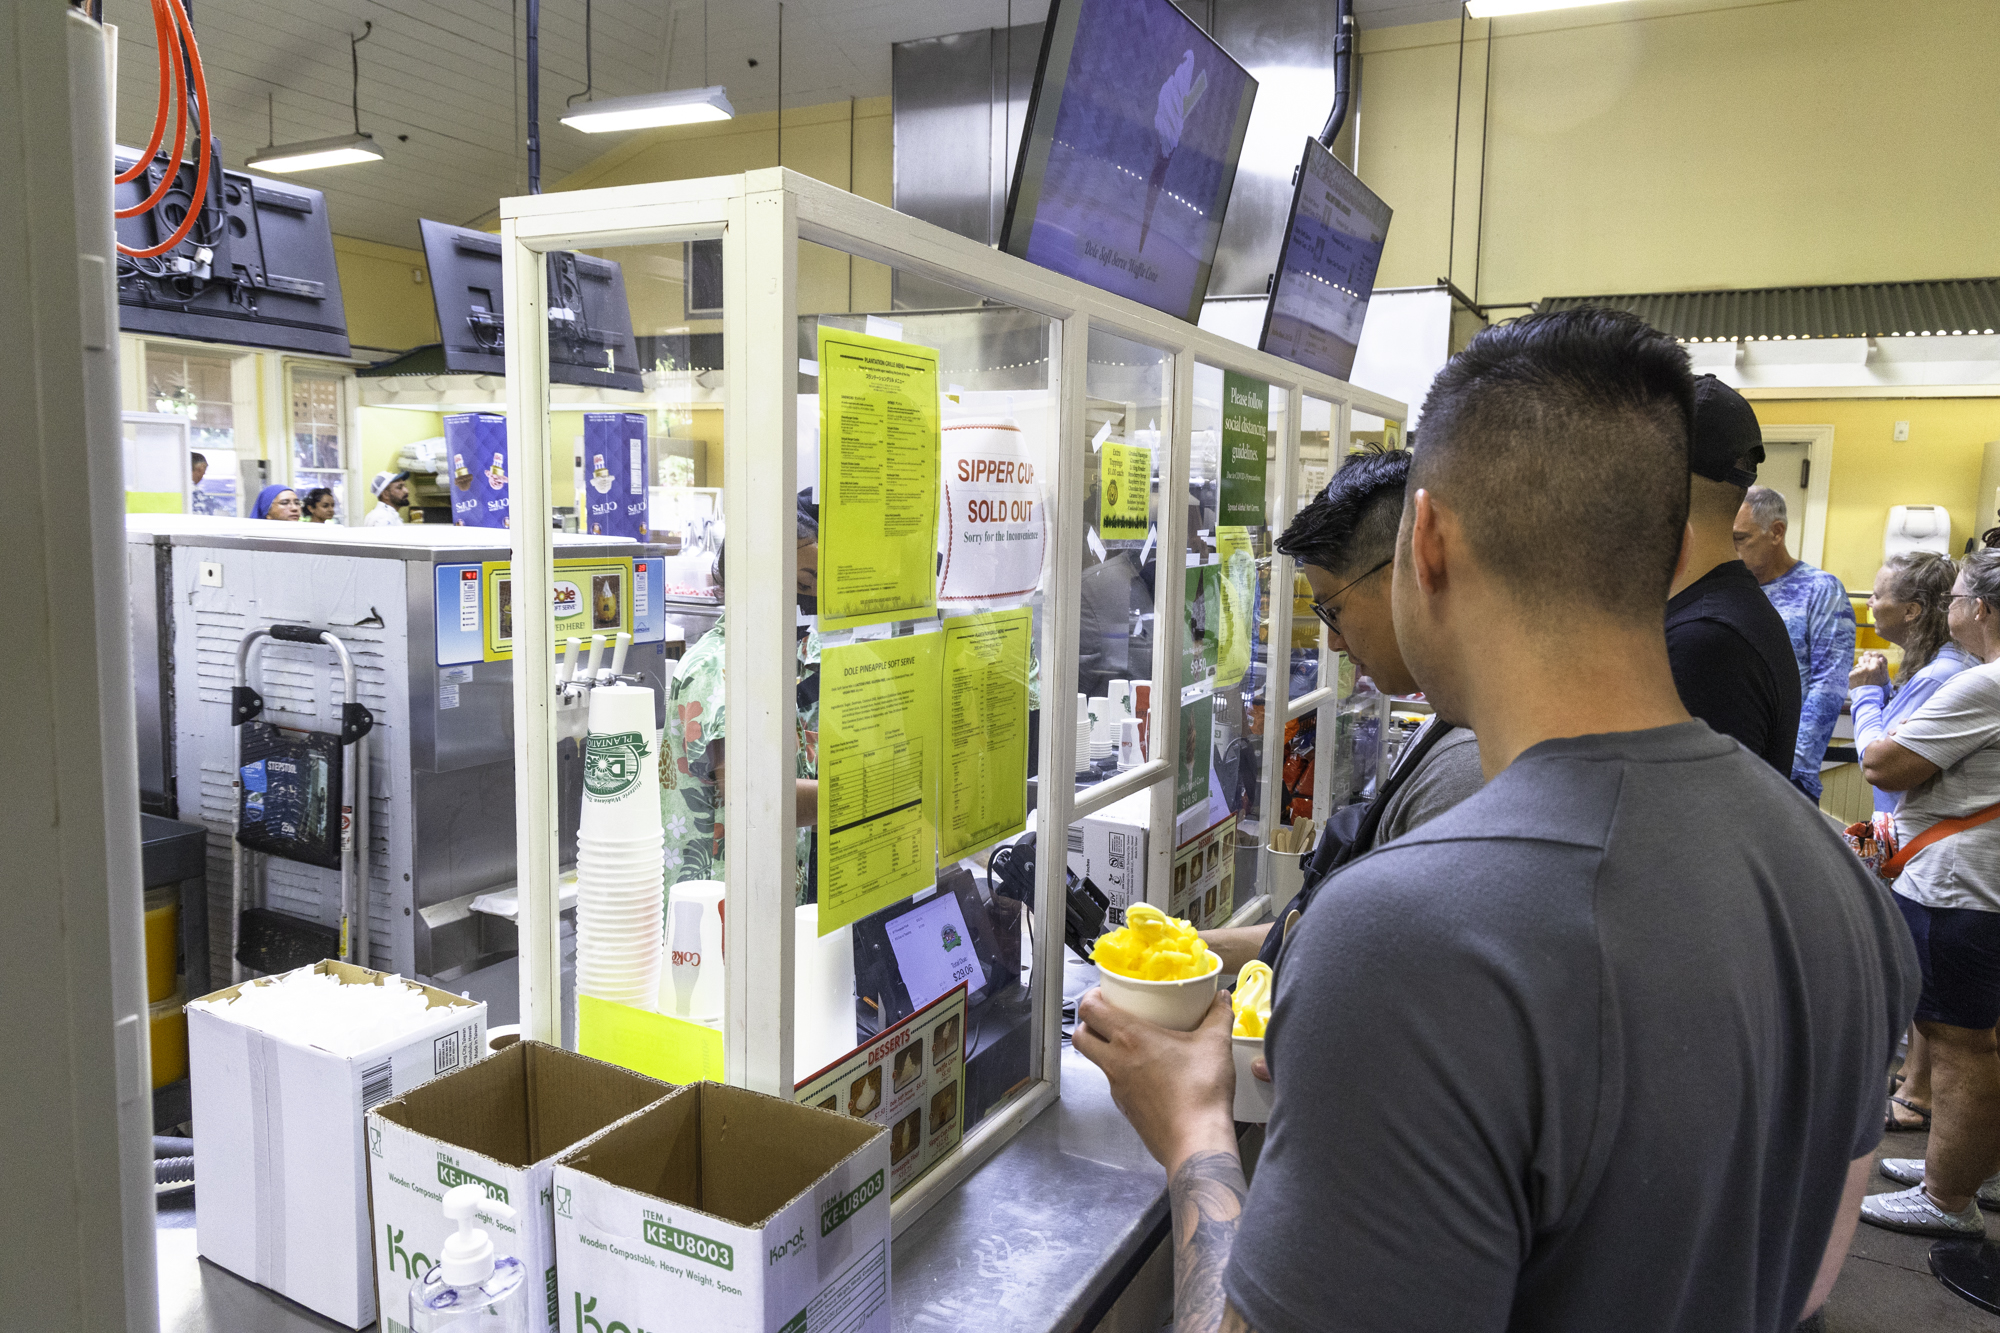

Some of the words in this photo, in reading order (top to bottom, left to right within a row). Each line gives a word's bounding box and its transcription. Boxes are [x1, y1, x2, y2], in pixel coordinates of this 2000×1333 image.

[1231, 387, 1247, 406] Please
[1248, 391, 1263, 410] follow
[1225, 416, 1240, 432] social
[1241, 416, 1266, 442] distancing
[1232, 443, 1258, 463] guidelines.
[958, 459, 1014, 483] SIPPER
[1018, 462, 1034, 484] CUP
[1110, 458, 1123, 468] Toppings
[968, 500, 1007, 523] SOLD
[1011, 500, 1033, 522] OUT
[964, 531, 982, 545] Sorry
[984, 531, 994, 542] for
[995, 531, 1005, 541] the
[1007, 530, 1038, 541] Inconvenience
[566, 622, 585, 630] HERE!
[844, 666, 858, 676] DOLE
[860, 662, 886, 673] PINEAPPLE
[888, 659, 900, 668] SOFT
[901, 656, 915, 666] SERVE
[588, 734, 633, 748] PLANTATIO
[268, 761, 297, 774] STEPSTOOL
[622, 780, 642, 798] Historic
[951, 959, 960, 968] Total
[953, 964, 974, 982] $29.06
[868, 1028, 910, 1067] DESSERTS
[437, 1151, 453, 1164] ITEM
[891, 1159, 910, 1176] Pineapple
[388, 1172, 411, 1189] Wooden
[496, 1221, 516, 1234] Spoon
[820, 1196, 838, 1213] ITEM
[823, 1175, 882, 1232] KE-U8003
[643, 1209, 664, 1222] ITEM
[646, 1224, 730, 1265] KE-U8003
[770, 1226, 804, 1266] Karat
[579, 1234, 607, 1251] Wooden
[609, 1244, 658, 1268] Compostable,
[660, 1260, 683, 1279] Heavy
[685, 1269, 714, 1288] Weight,
[717, 1280, 742, 1296] Spoon
[807, 1299, 823, 1314] Wooden
